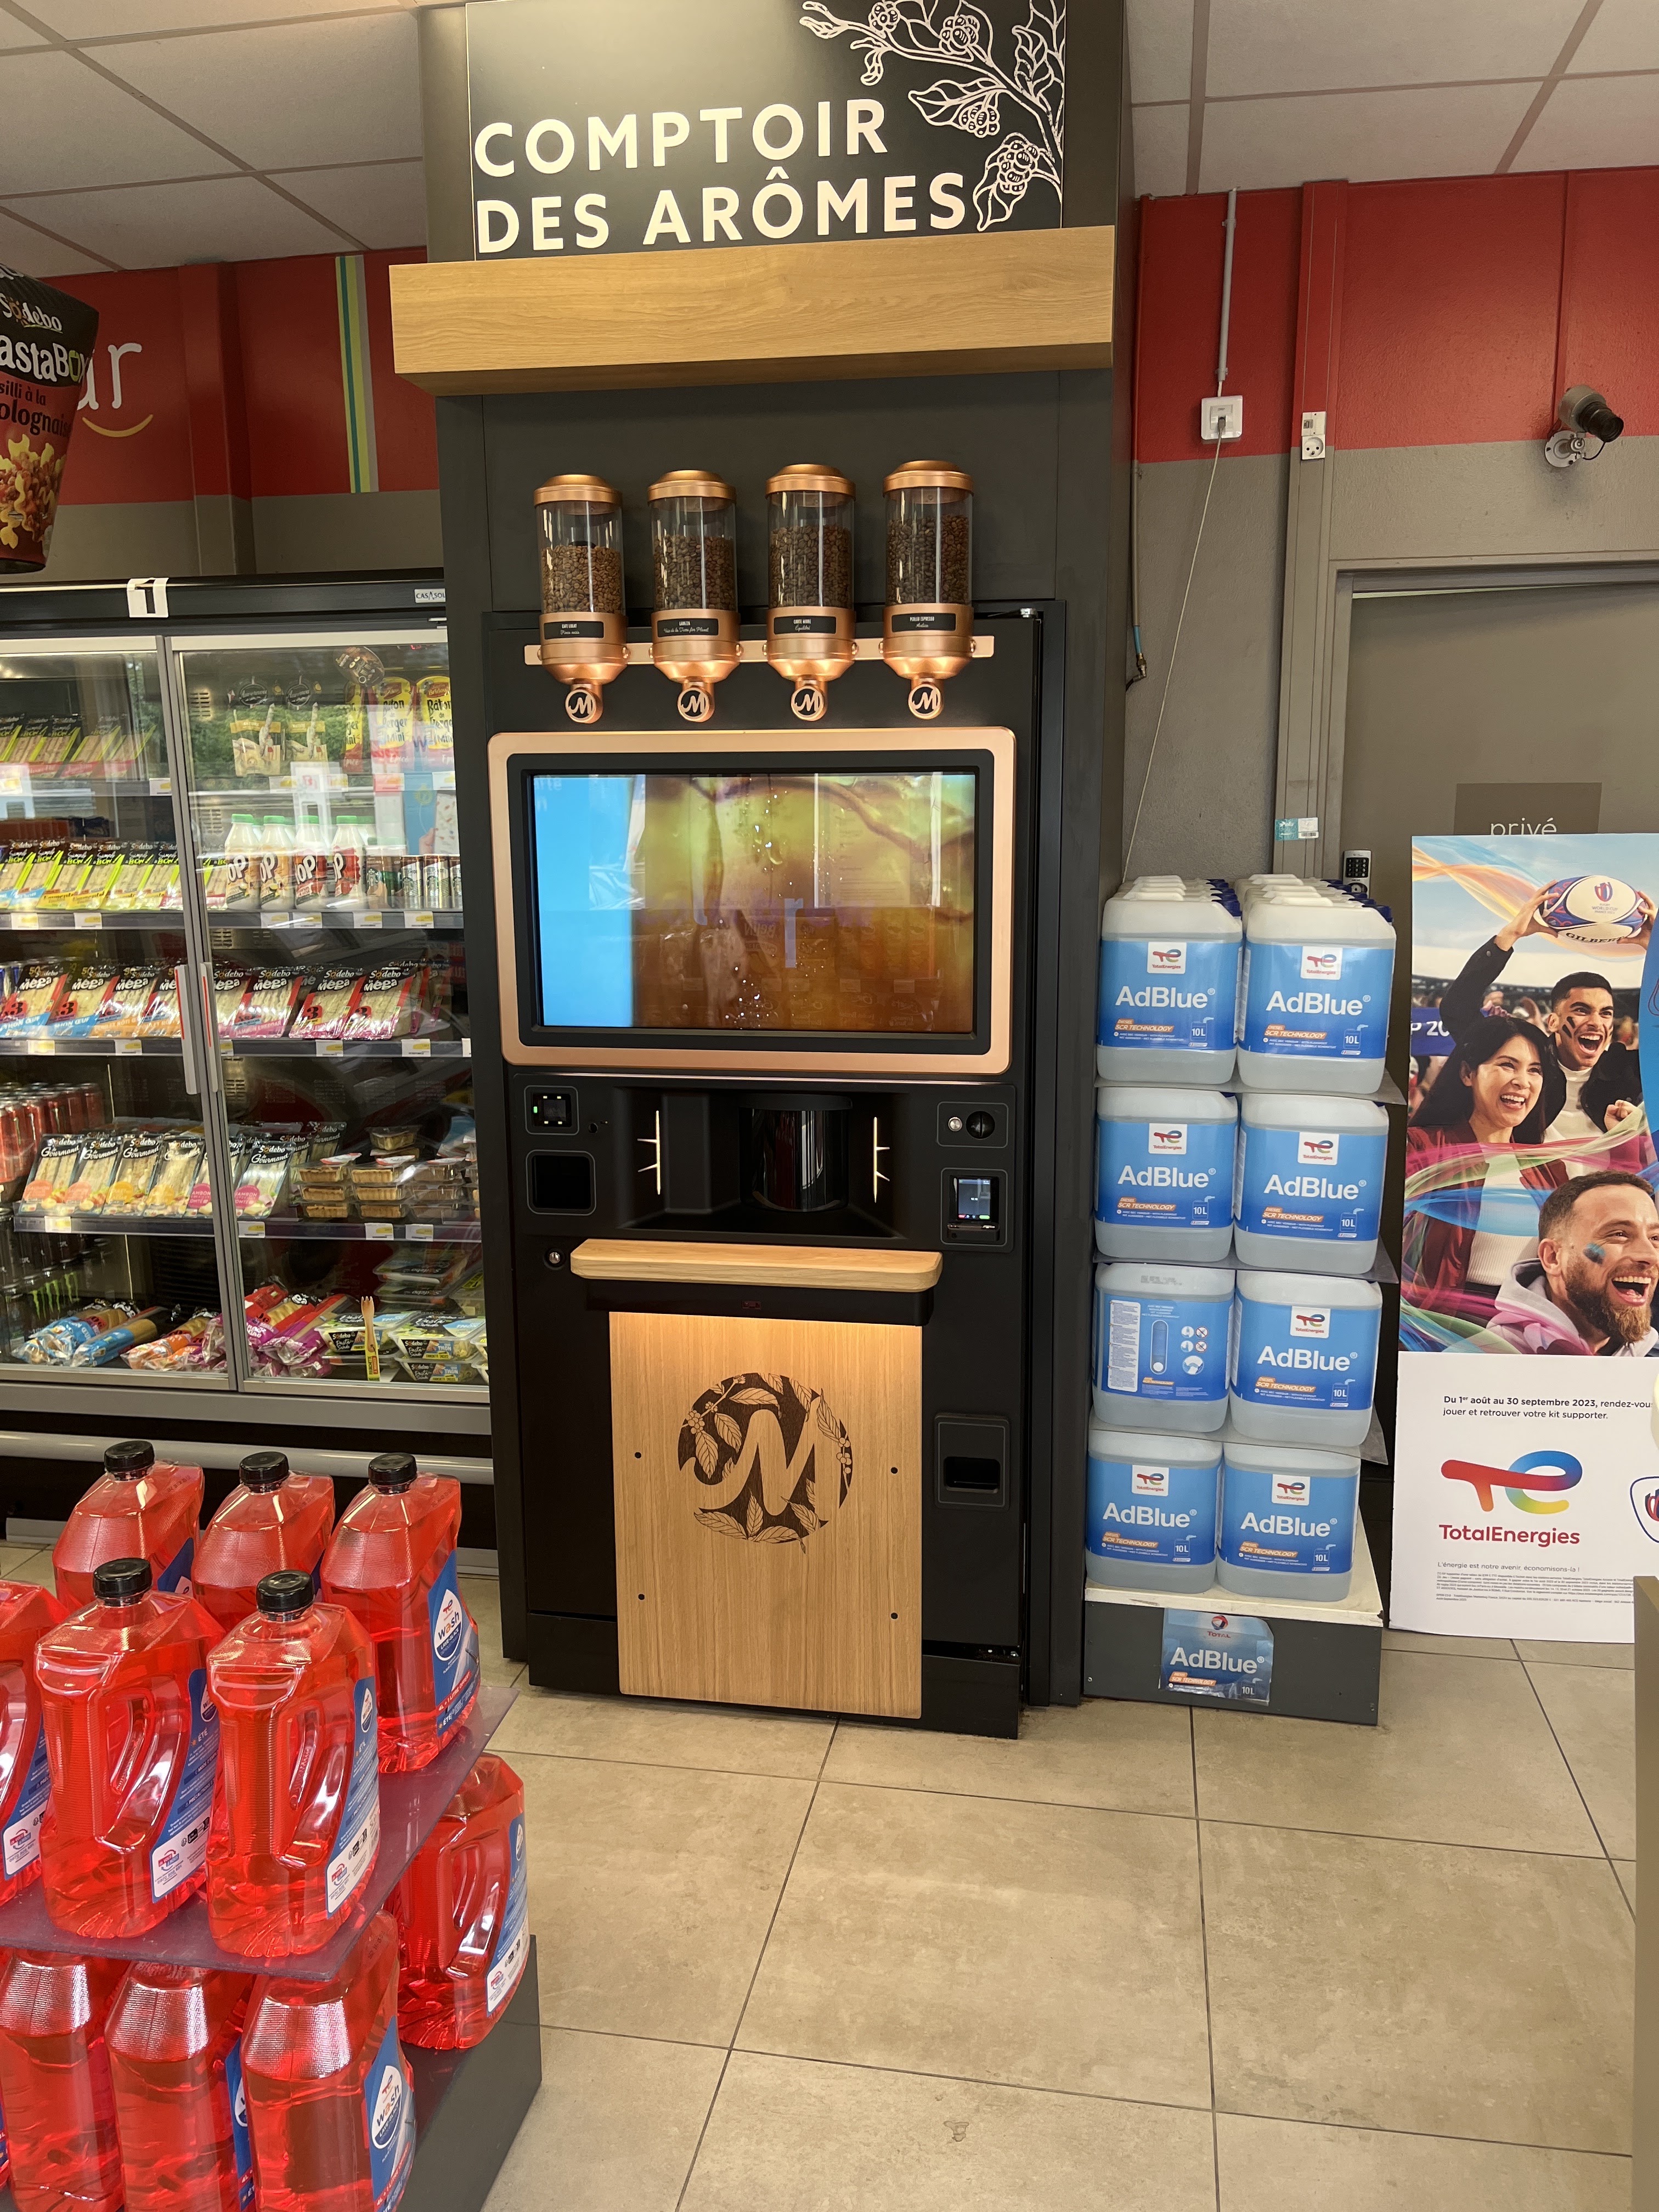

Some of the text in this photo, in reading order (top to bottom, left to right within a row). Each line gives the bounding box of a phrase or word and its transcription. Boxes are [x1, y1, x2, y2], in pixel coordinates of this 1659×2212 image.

[474, 98, 888, 178] COMPTOIR
[477, 166, 966, 254] DES ARÔMES
[36, 390, 46, 405] la
[228, 856, 246, 883] OP
[214, 970, 244, 979] Sodebo
[259, 970, 291, 979] Sodebo
[324, 970, 354, 978] Sodebo
[369, 970, 401, 979] Sodebo
[90, 1141, 116, 1149] Sodebo
[129, 1138, 156, 1147] Sodebo
[41, 1146, 80, 1158] Gourmand
[83, 1147, 119, 1160] Gourmand
[123, 1145, 159, 1158] Gourmand
[258, 1146, 285, 1154] Sodebo
[251, 1153, 289, 1164] Gourmand
[1278, 1213, 1322, 1221] TECHNOLOGY
[1270, 1383, 1314, 1392] TECHNOLOGY
[1444, 1396, 1457, 1404] Du
[1470, 1397, 1491, 1405] août
[1506, 1397, 1519, 1406] 30
[1521, 1397, 1570, 1408] septembre
[1572, 1399, 1598, 1408] 2023,
[1443, 1408, 1466, 1417] jouer
[1549, 1409, 1560, 1418] kit
[1562, 1411, 1609, 1420] supporter.
[1116, 1538, 1158, 1547] TECHNOLOGY
[1439, 1525, 1580, 1548] TotalEnergies
[1254, 1548, 1297, 1557] TECHNOLOGY
[1437, 1561, 1468, 1570] L'énergie
[1523, 1564, 1576, 1573] économisons-la
[438, 1612, 460, 1640] wash
[1207, 1630, 1231, 1639] TOTAL
[449, 1689, 460, 1701] LITRE
[459, 1671, 471, 1690] OFFERT
[443, 1714, 452, 1726] ÉTÉ
[198, 1728, 208, 1742] ÉTÉ
[377, 2084, 399, 2127] wash
